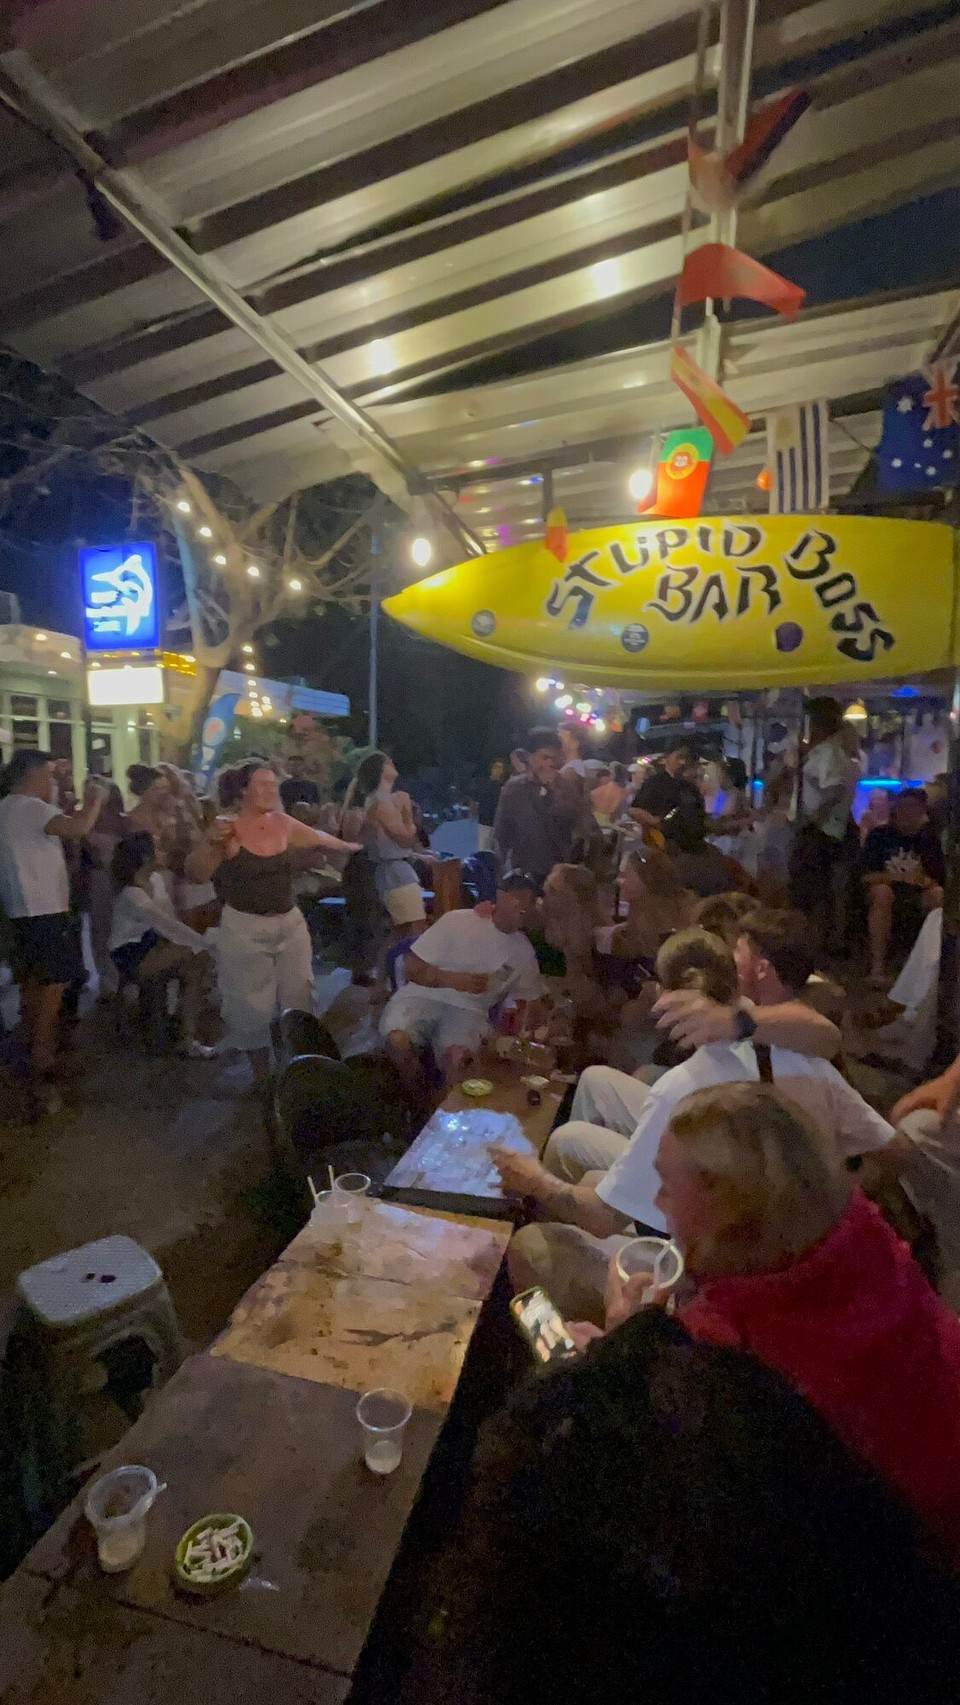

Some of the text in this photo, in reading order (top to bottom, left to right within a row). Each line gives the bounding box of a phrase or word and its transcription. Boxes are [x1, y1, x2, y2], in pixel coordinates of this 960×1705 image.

[546, 524, 895, 662] STUPID BOSS
[648, 564, 781, 622] BAR
